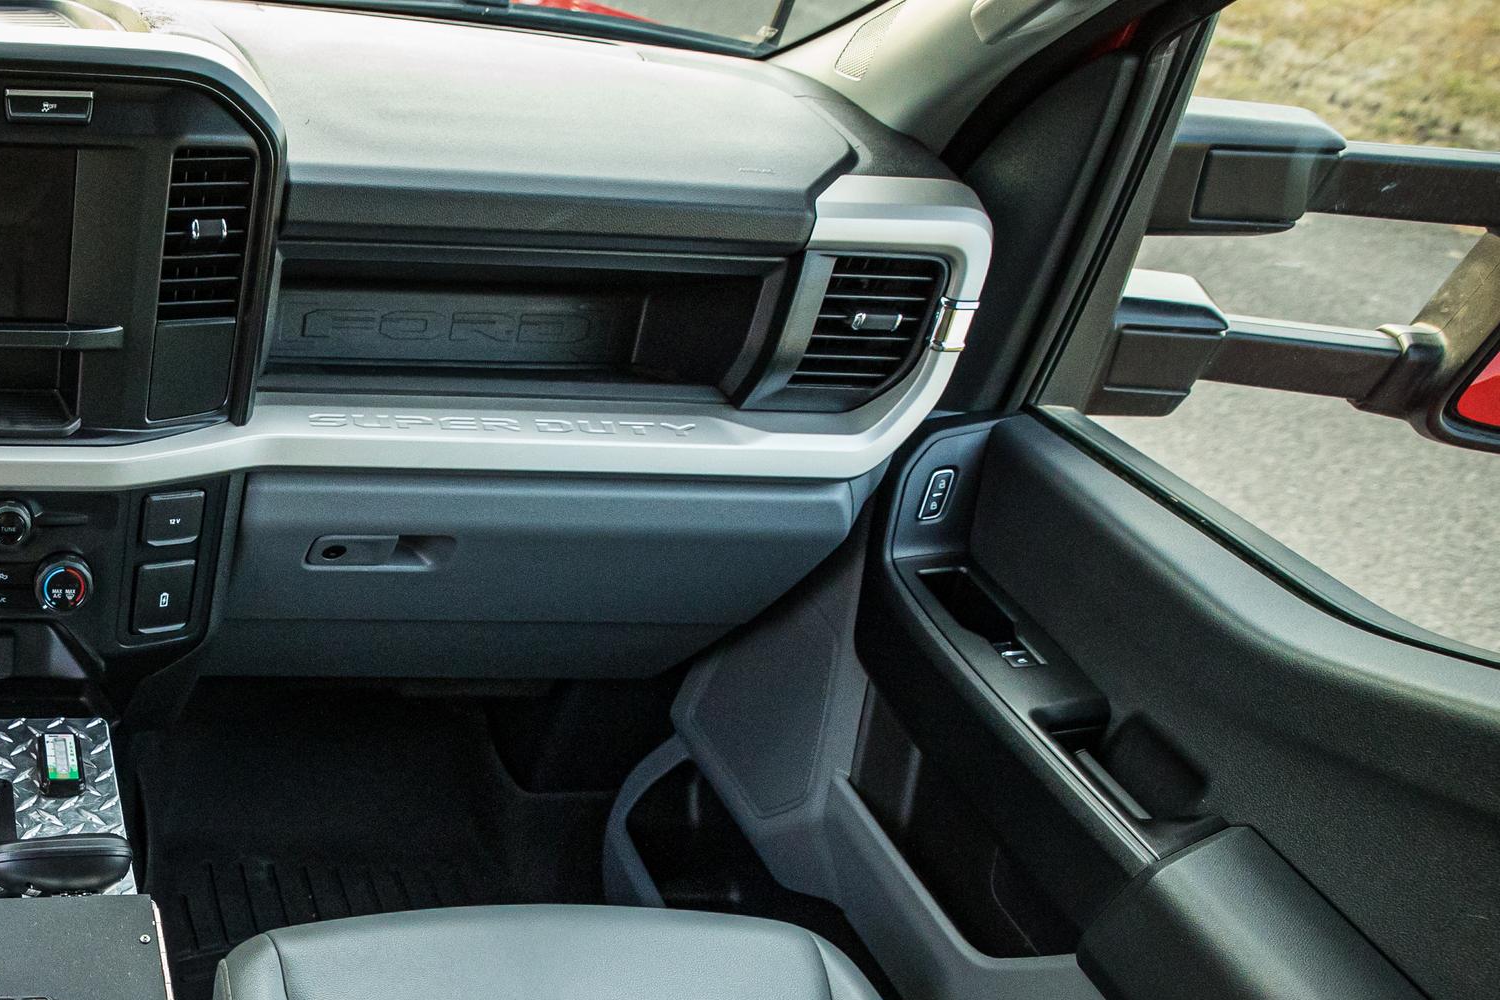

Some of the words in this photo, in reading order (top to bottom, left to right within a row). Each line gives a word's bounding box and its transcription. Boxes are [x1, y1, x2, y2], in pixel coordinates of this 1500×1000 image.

[301, 309, 594, 345] FORD
[308, 412, 521, 432] SUPER
[534, 417, 697, 437] DUTY
